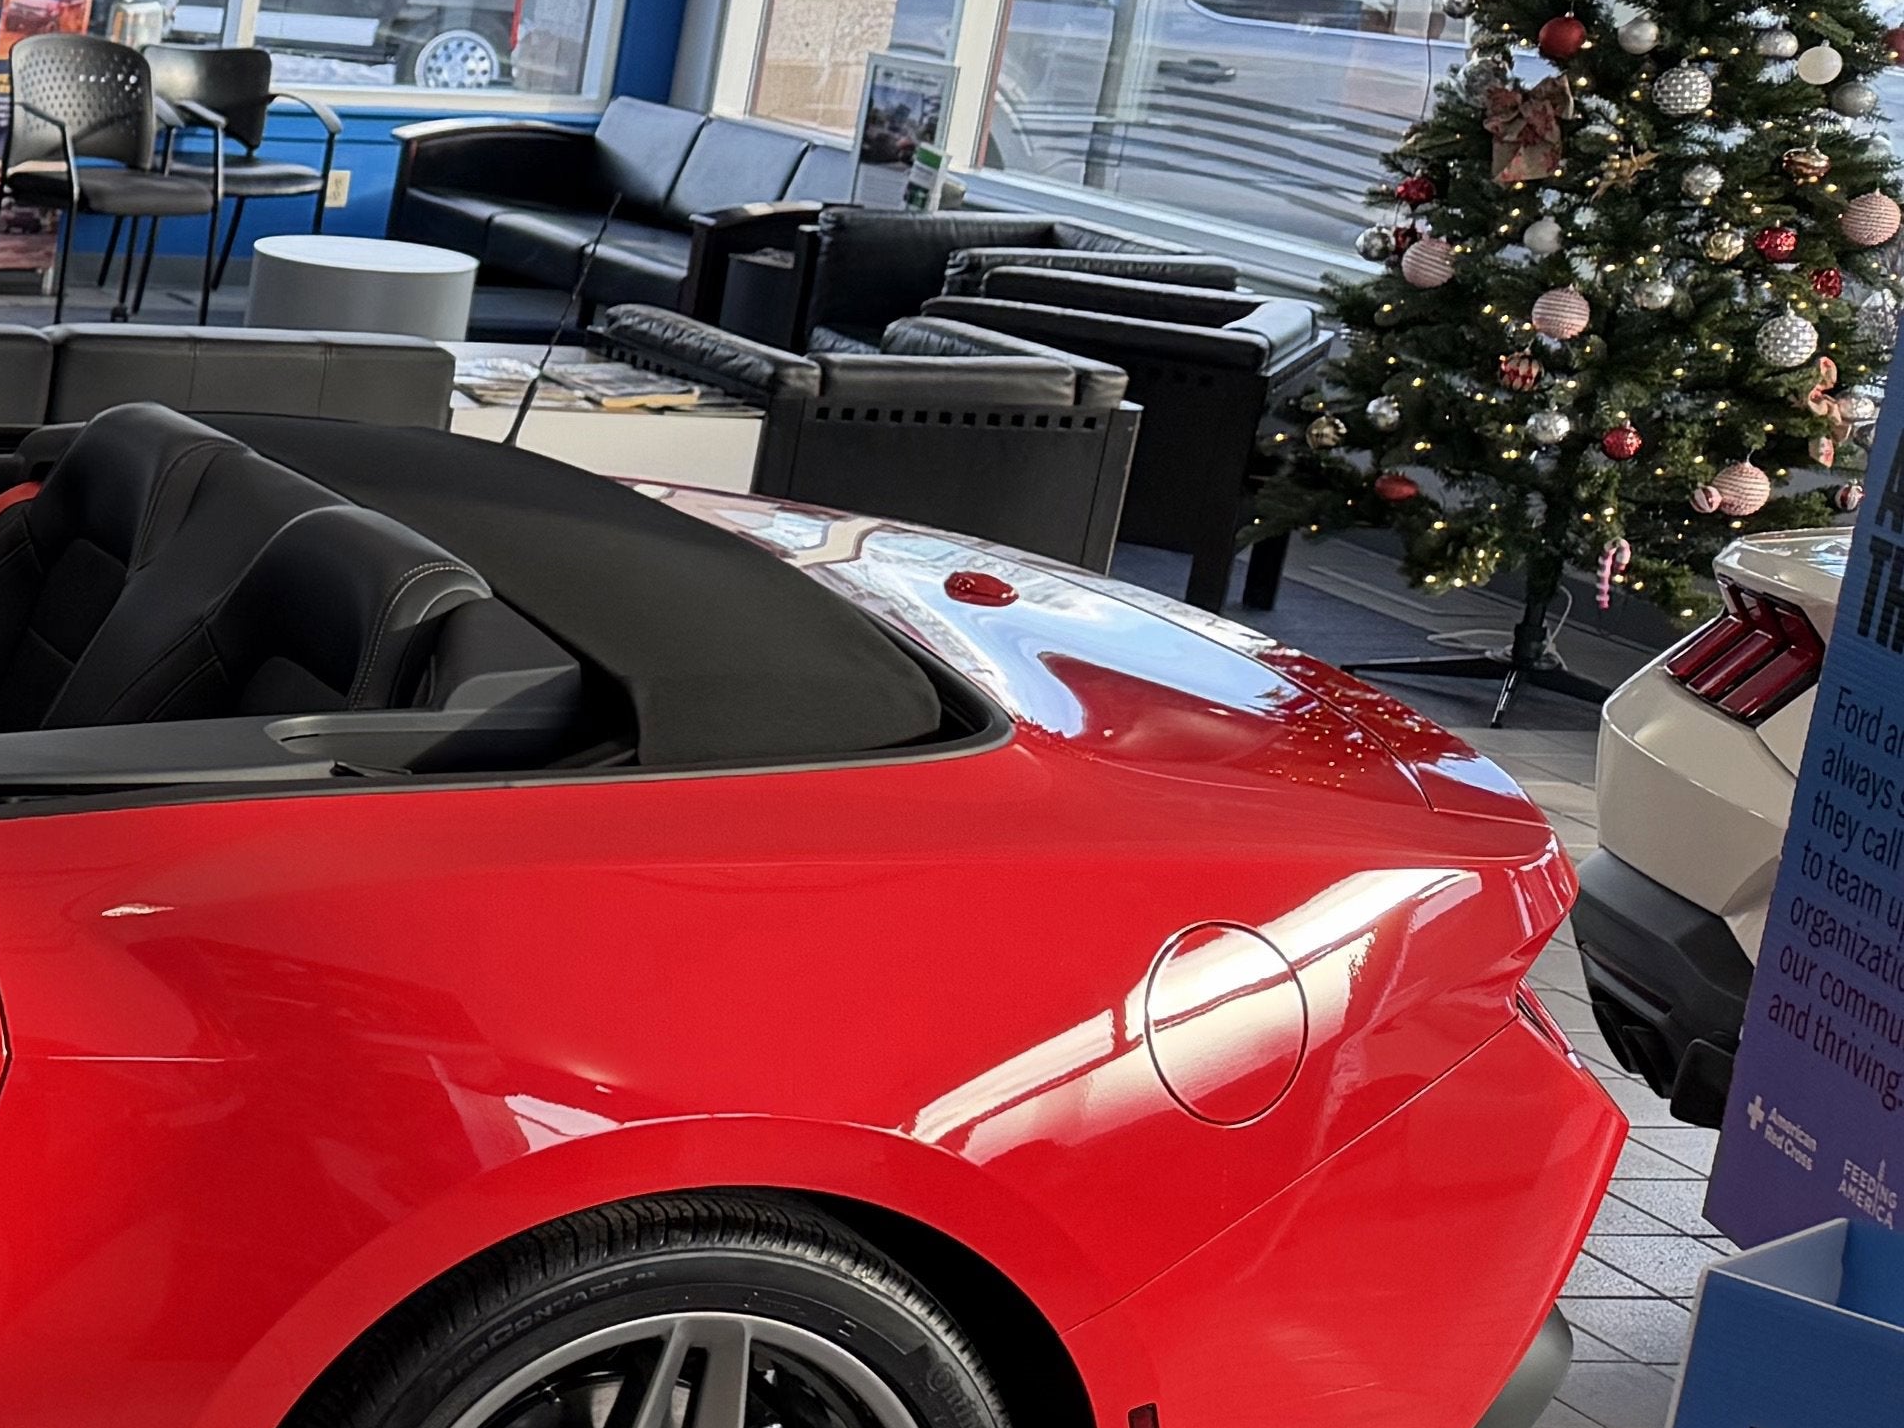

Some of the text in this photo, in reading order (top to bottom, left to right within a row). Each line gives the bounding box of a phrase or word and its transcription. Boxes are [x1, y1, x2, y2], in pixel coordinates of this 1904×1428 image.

[1834, 686, 1883, 745] Ford
[1822, 742, 1895, 810] always
[1811, 789, 1904, 871] they call
[1801, 839, 1823, 881] to
[1826, 858, 1883, 918] team
[1779, 945, 1818, 989] our
[1768, 994, 1903, 1112] and thriving.
[1764, 1123, 1813, 1171] Red Cross
[1767, 1107, 1817, 1152] American
[1838, 1178, 1894, 1230] AMERICA
[1843, 1159, 1898, 1209] FEEDING
